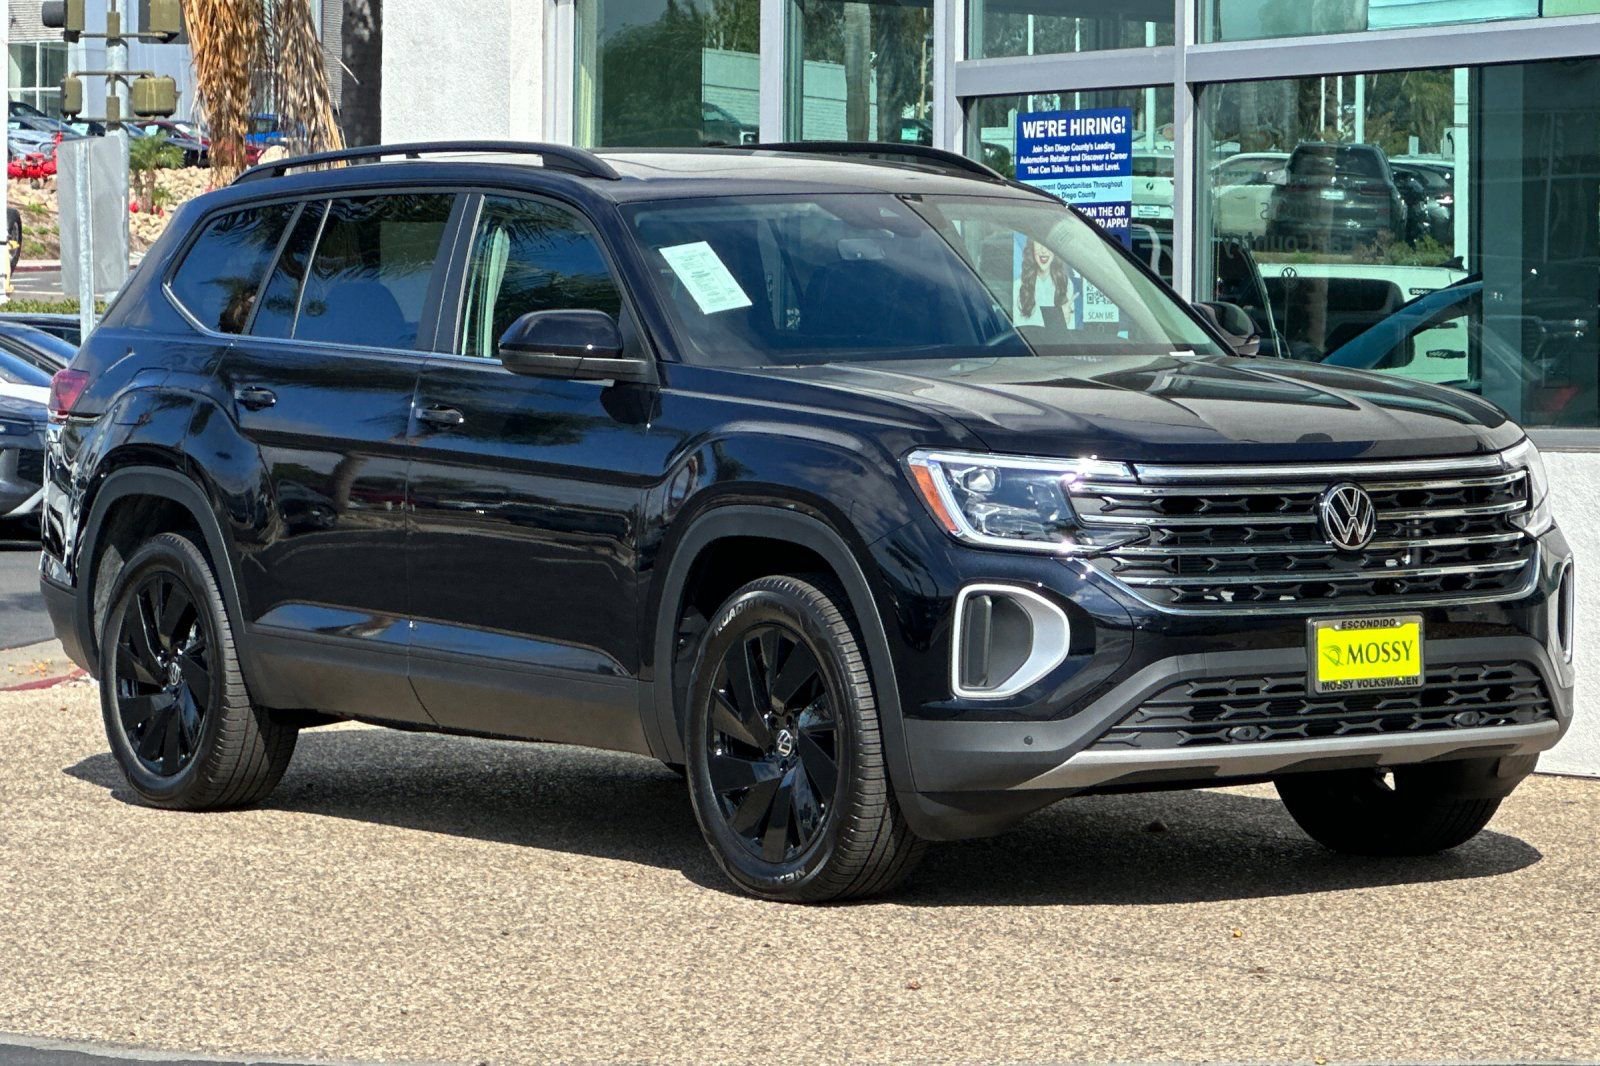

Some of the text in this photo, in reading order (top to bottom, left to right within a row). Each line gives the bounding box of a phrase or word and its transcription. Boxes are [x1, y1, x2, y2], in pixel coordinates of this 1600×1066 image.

[1022, 116, 1126, 139] WE'RE HIRING!
[1032, 141, 1116, 154] Join San Diego County's Leading
[1020, 156, 1049, 164] Automotive
[1050, 154, 1070, 163] Retailer
[1071, 153, 1081, 162] and
[1082, 153, 1105, 161] Discover
[1110, 152, 1128, 160] Career
[1027, 166, 1039, 174] That
[1040, 165, 1051, 174] Can
[1051, 165, 1064, 173] Take
[1064, 164, 1075, 173] You
[1081, 164, 1090, 172] the
[1091, 163, 1104, 171] Next
[1105, 162, 1120, 171] Level.
[1056, 181, 1092, 190] Opportunities
[1093, 180, 1123, 189] Throughout
[1061, 192, 1077, 200] Diego
[1078, 191, 1097, 199] County
[1098, 206, 1114, 217] THE
[1114, 205, 1126, 216] QR
[1106, 217, 1129, 229] APPLY
[1087, 311, 1115, 320] SCAN ME
[1341, 618, 1396, 629] ESCONDIDO
[1346, 640, 1413, 665] MOSSY
[1321, 677, 1419, 691] MOSSY VOLKSWAGEN
